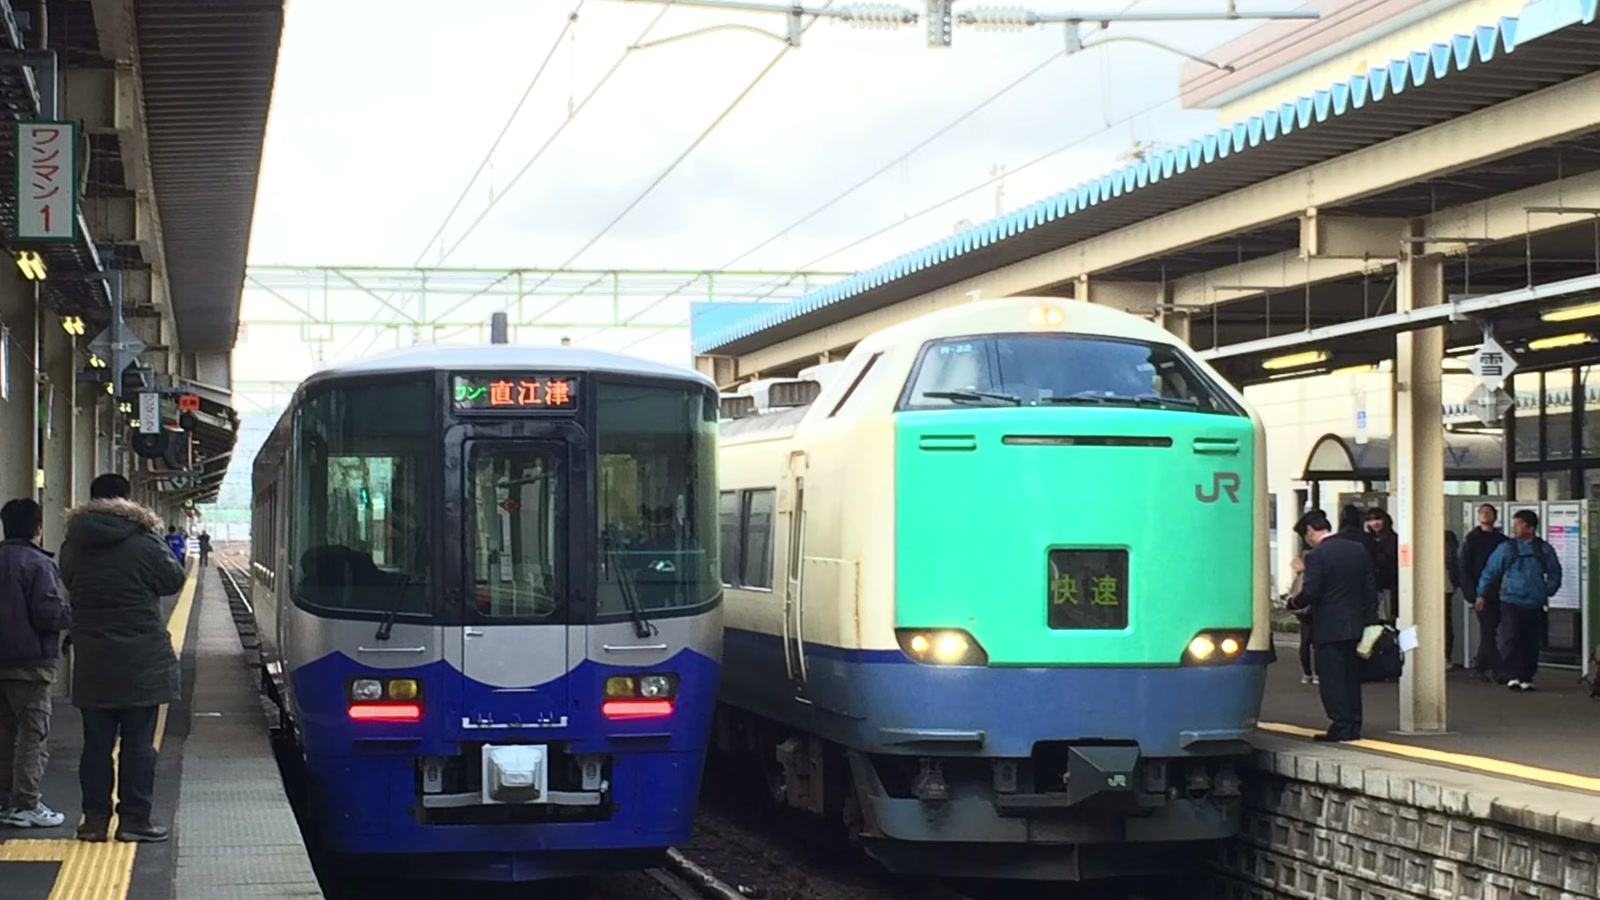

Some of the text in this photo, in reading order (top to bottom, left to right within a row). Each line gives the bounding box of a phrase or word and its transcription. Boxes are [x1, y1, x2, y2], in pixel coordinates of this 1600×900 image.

[1480, 352, 1503, 376] 雪
[490, 380, 569, 405] 直江津
[1195, 472, 1240, 503] JR
[1051, 574, 1118, 605] 快速
[1108, 775, 1126, 787] JR
